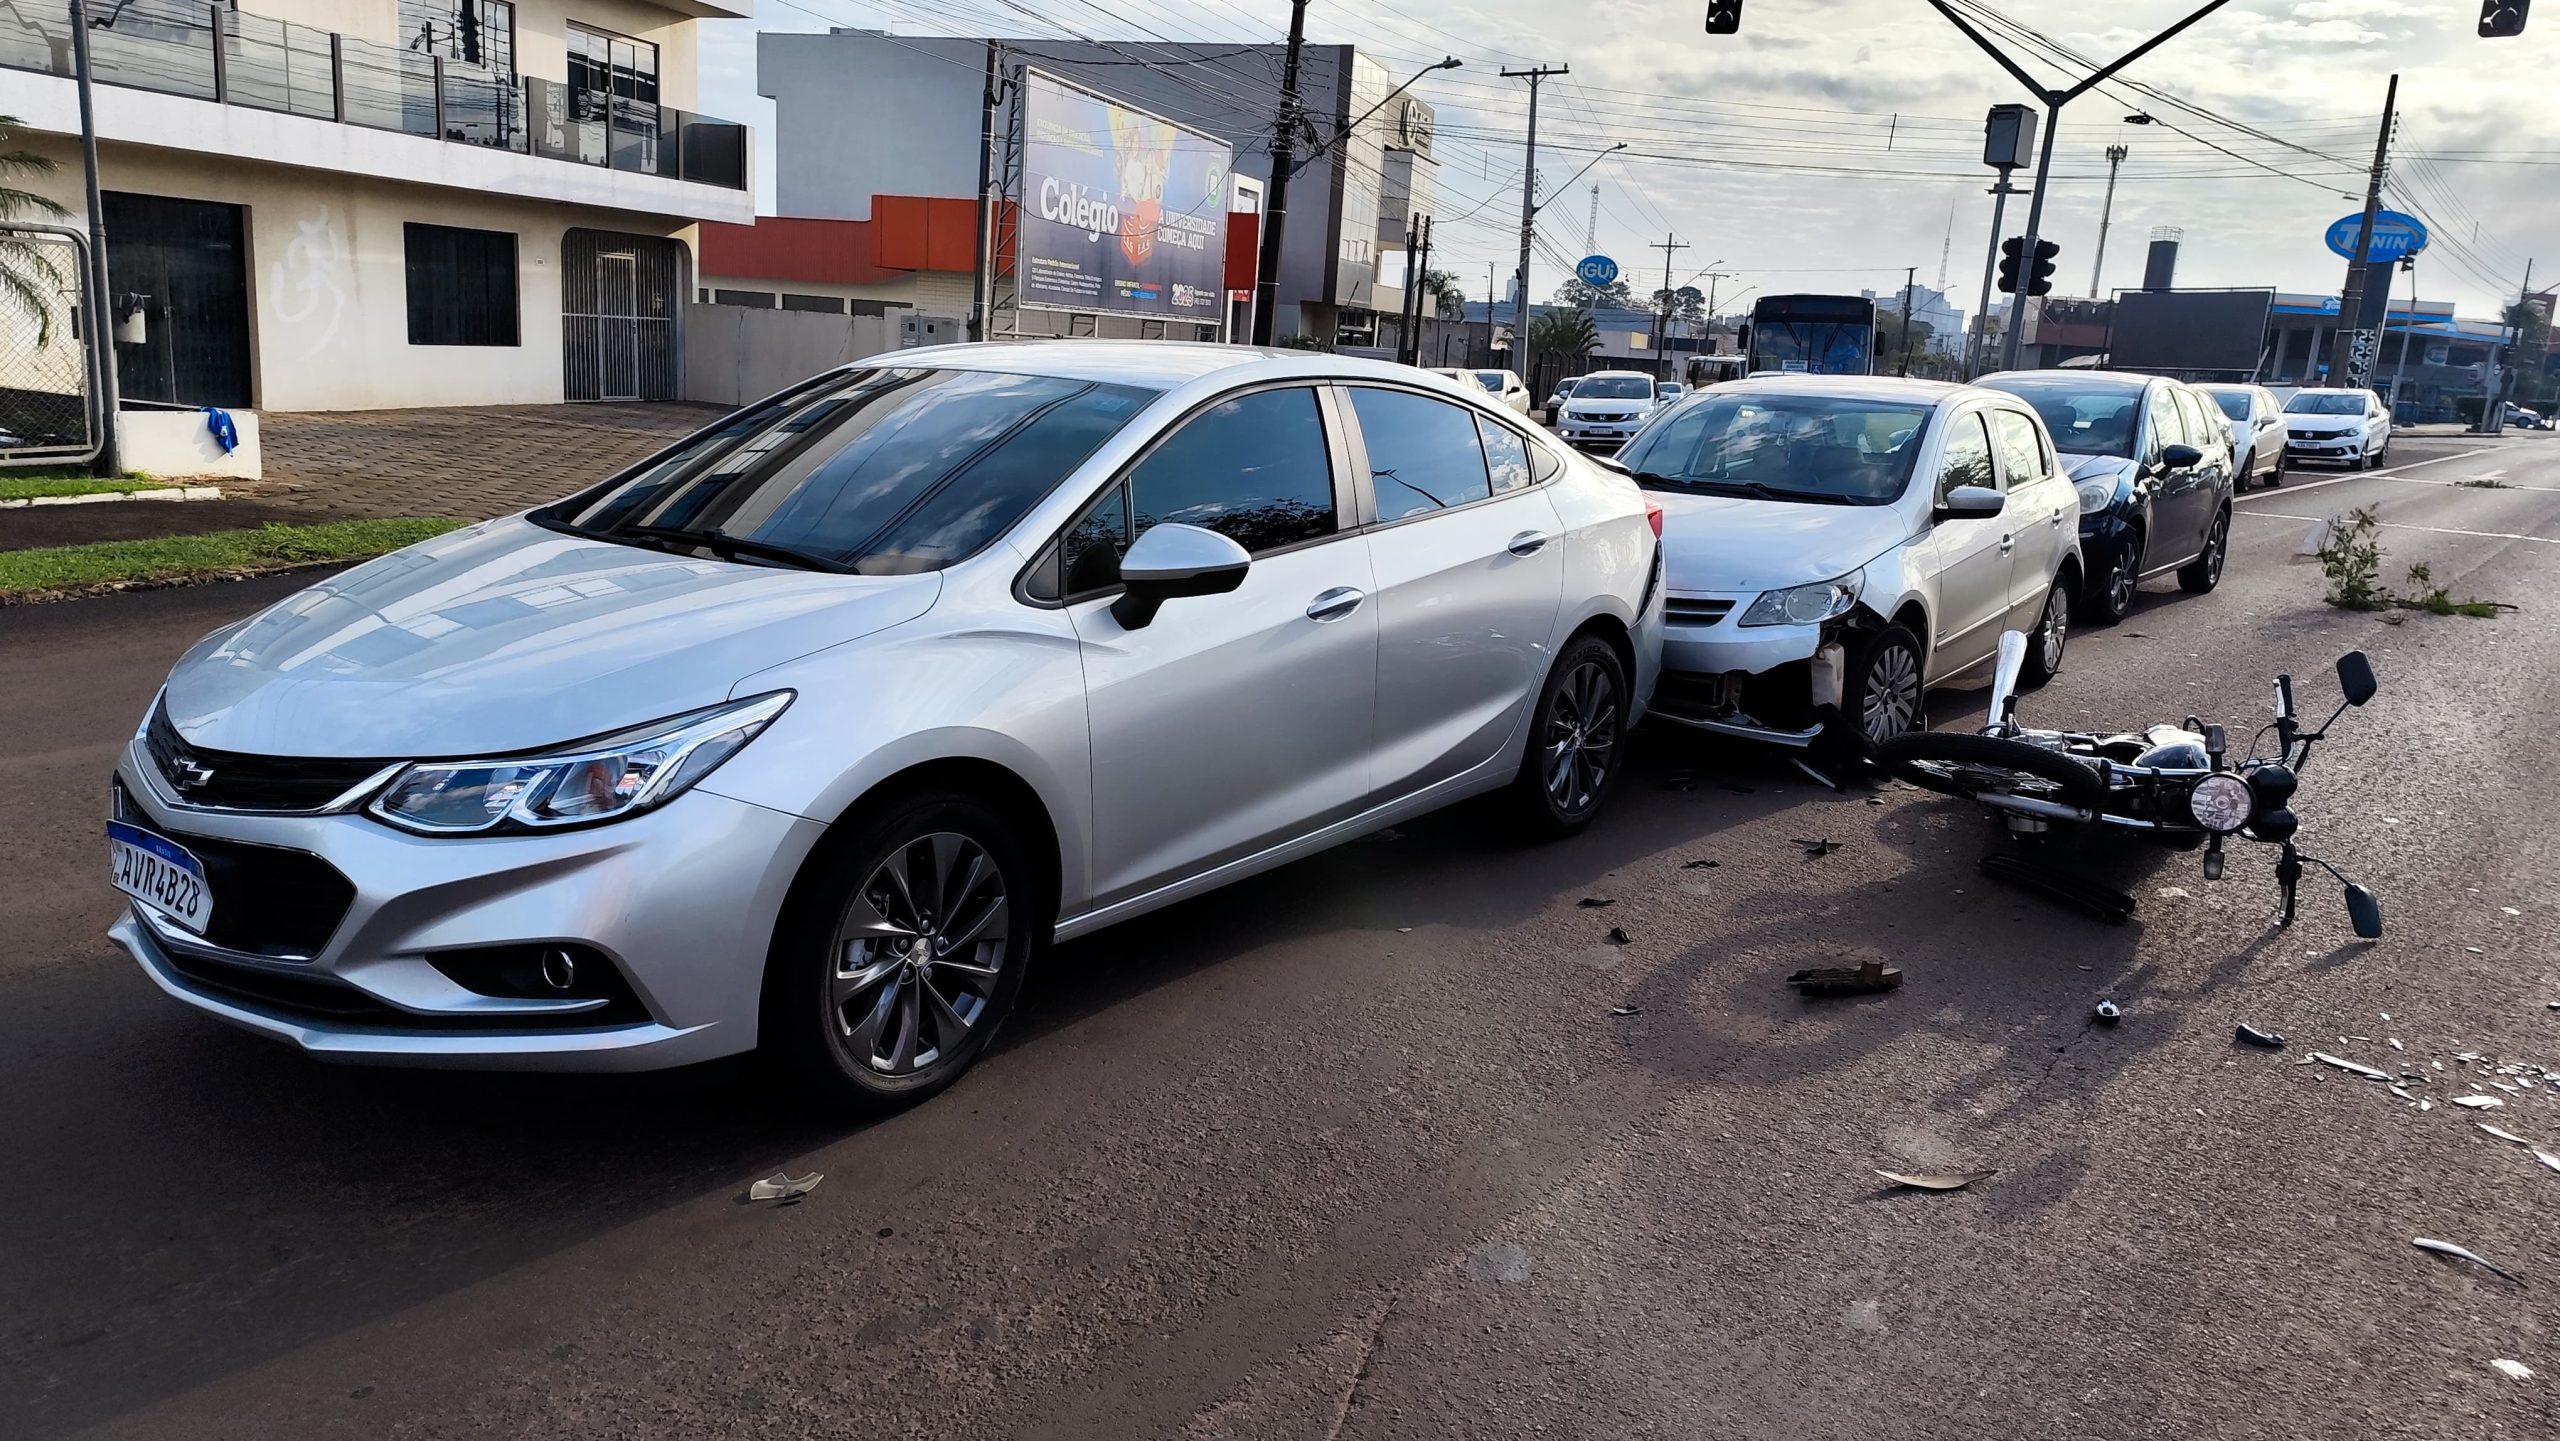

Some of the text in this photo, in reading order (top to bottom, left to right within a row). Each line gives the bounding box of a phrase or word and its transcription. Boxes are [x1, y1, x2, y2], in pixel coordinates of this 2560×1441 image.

[1040, 176, 1119, 243] Colégio
[1158, 208, 1217, 236] A UNIVERSIDADE
[1157, 226, 1205, 251] COMEÇA AQUI
[2340, 223, 2409, 249] TNIN
[1579, 262, 1614, 279] iGUi
[121, 847, 200, 918] AVR4B28
